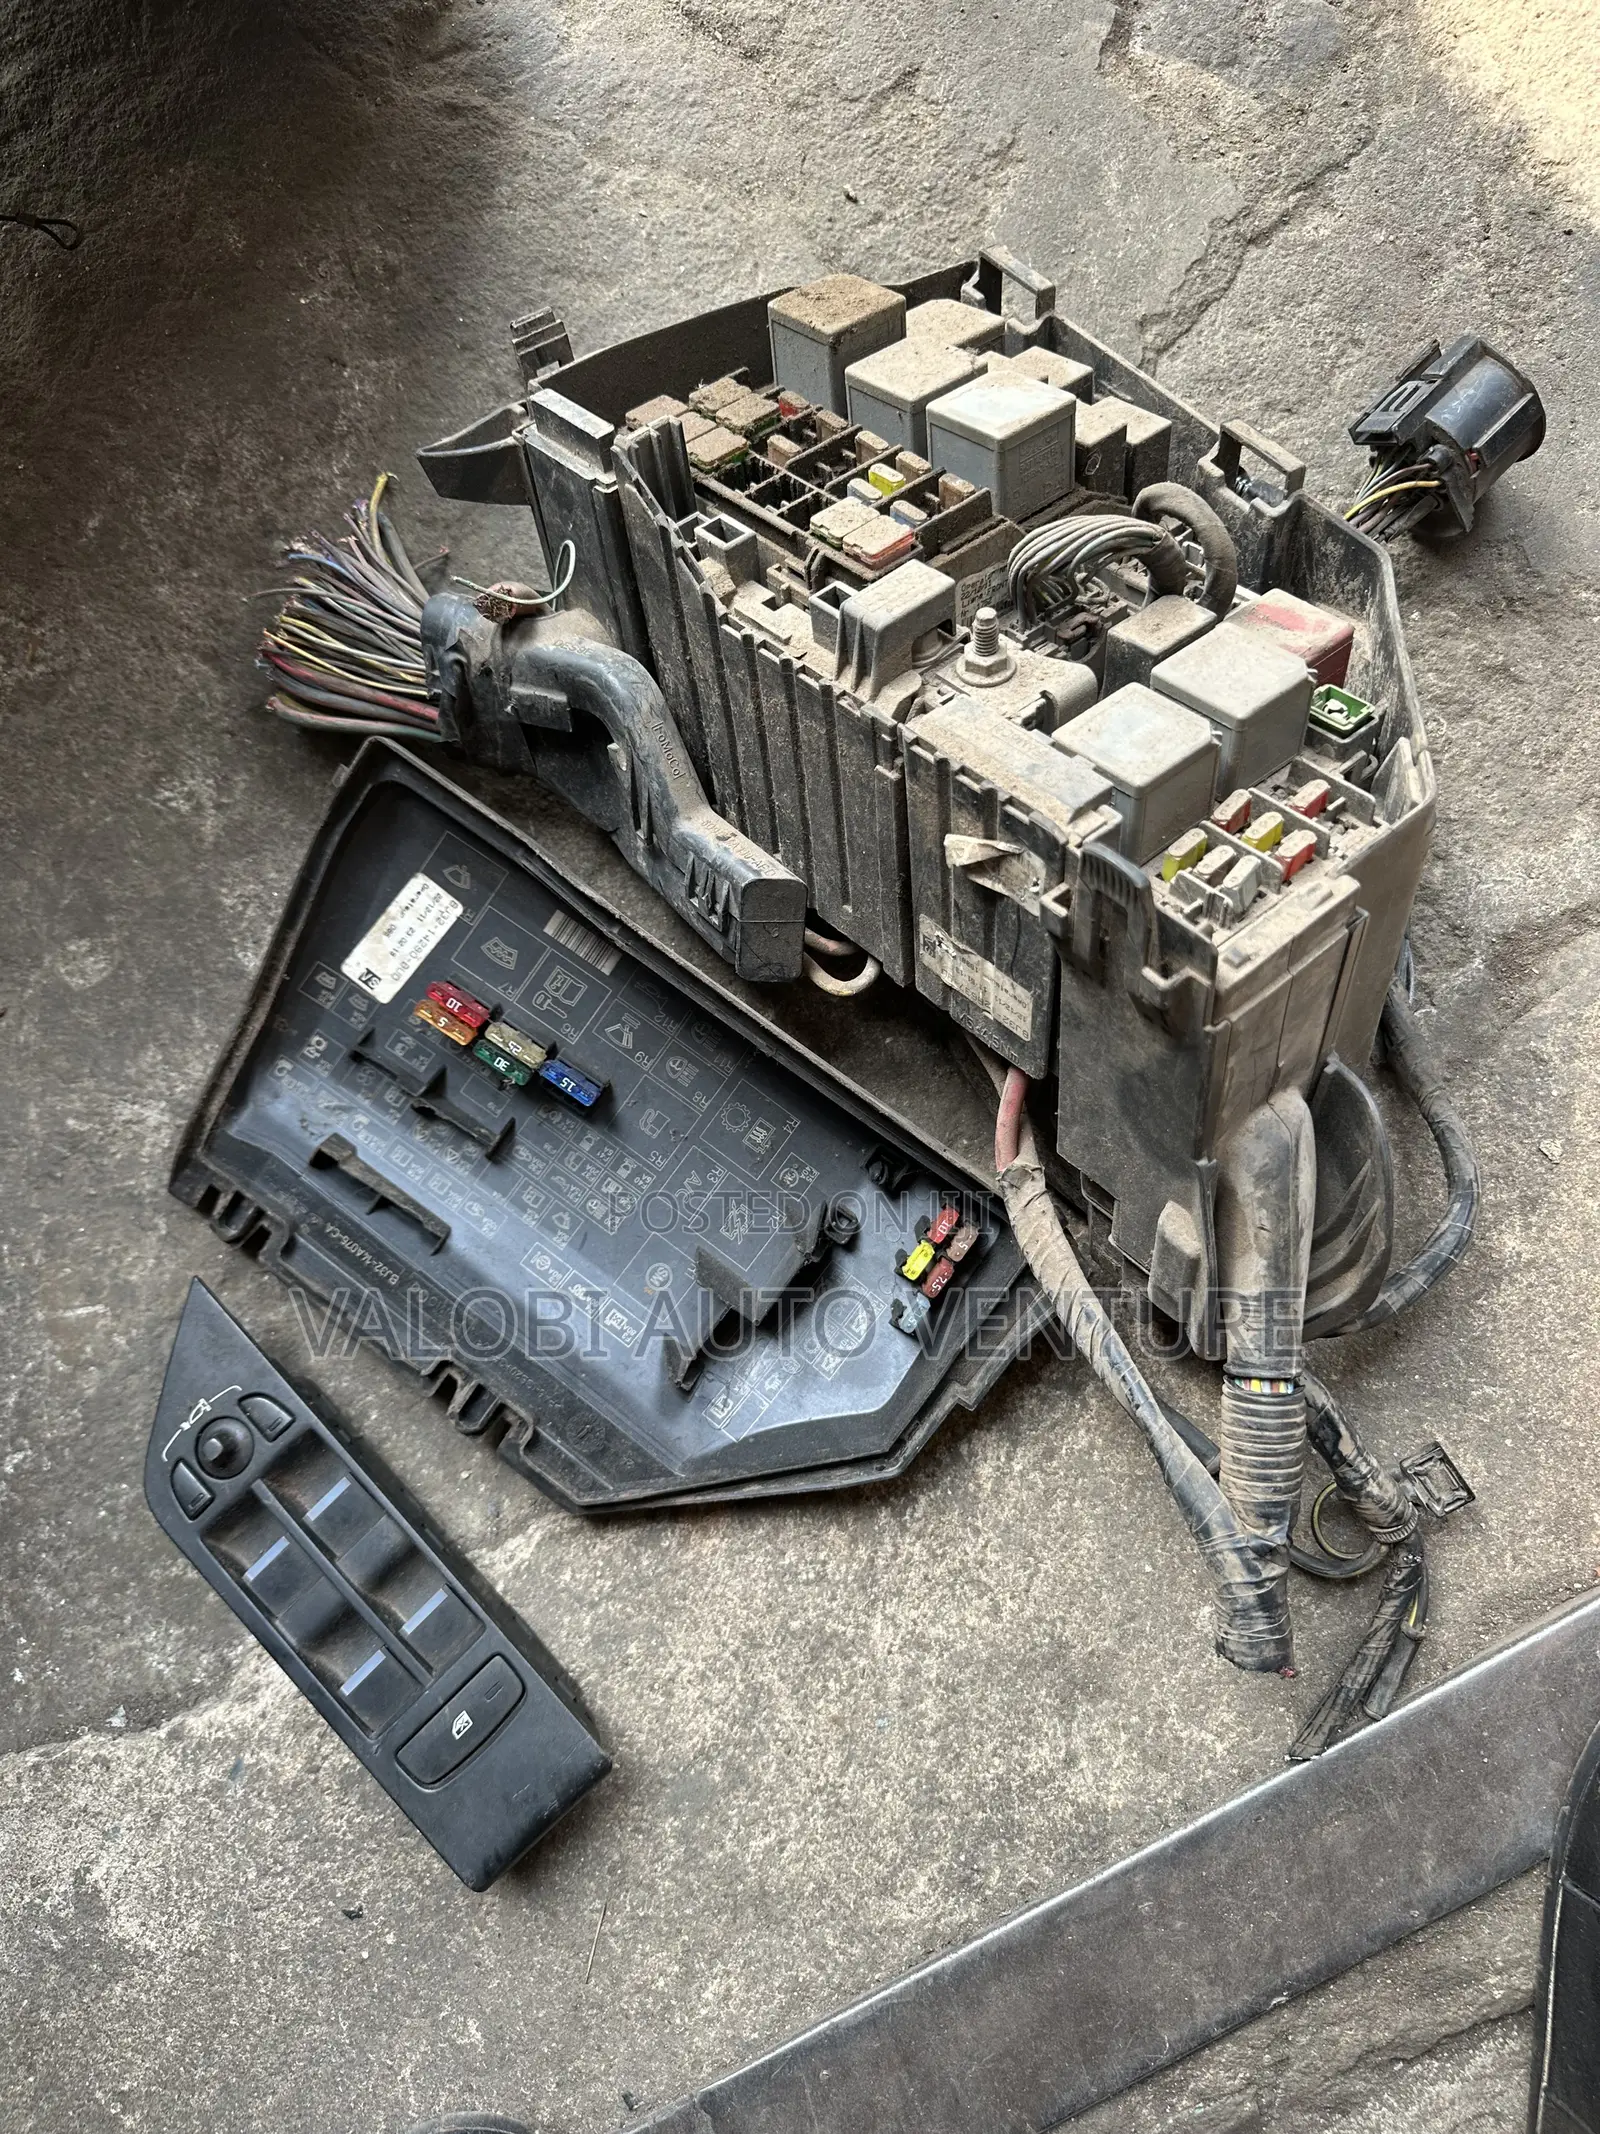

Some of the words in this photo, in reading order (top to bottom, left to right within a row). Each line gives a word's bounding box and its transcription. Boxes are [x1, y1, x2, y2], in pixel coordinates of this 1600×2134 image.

[496, 982, 520, 1000] R7
[445, 997, 463, 1013] 10
[437, 1016, 449, 1028] 5
[653, 1008, 679, 1034] R12
[559, 1022, 580, 1042] R6
[505, 1040, 523, 1056] 25
[493, 1056, 510, 1072] 30
[634, 1050, 655, 1070] R9
[559, 1077, 577, 1093] 15
[692, 1090, 708, 1109] R8
[595, 1148, 610, 1161] F41
[602, 1144, 614, 1156] 5A
[530, 1155, 546, 1169] 20A
[647, 1150, 667, 1168] R5
[526, 1161, 542, 1175] F32
[580, 1169, 595, 1183] F37
[584, 1163, 599, 1176] 20A
[706, 1164, 725, 1184] R3
[632, 1175, 648, 1189] F40
[640, 1171, 652, 1183] 5A
[568, 1183, 583, 1196] 15A
[672, 1169, 703, 1204] A/C
[565, 1189, 580, 1202] F31
[936, 1218, 952, 1235] 10
[957, 1240, 969, 1251] 5
[931, 1275, 948, 1291] 7.5
[620, 1332, 632, 1343] F3
